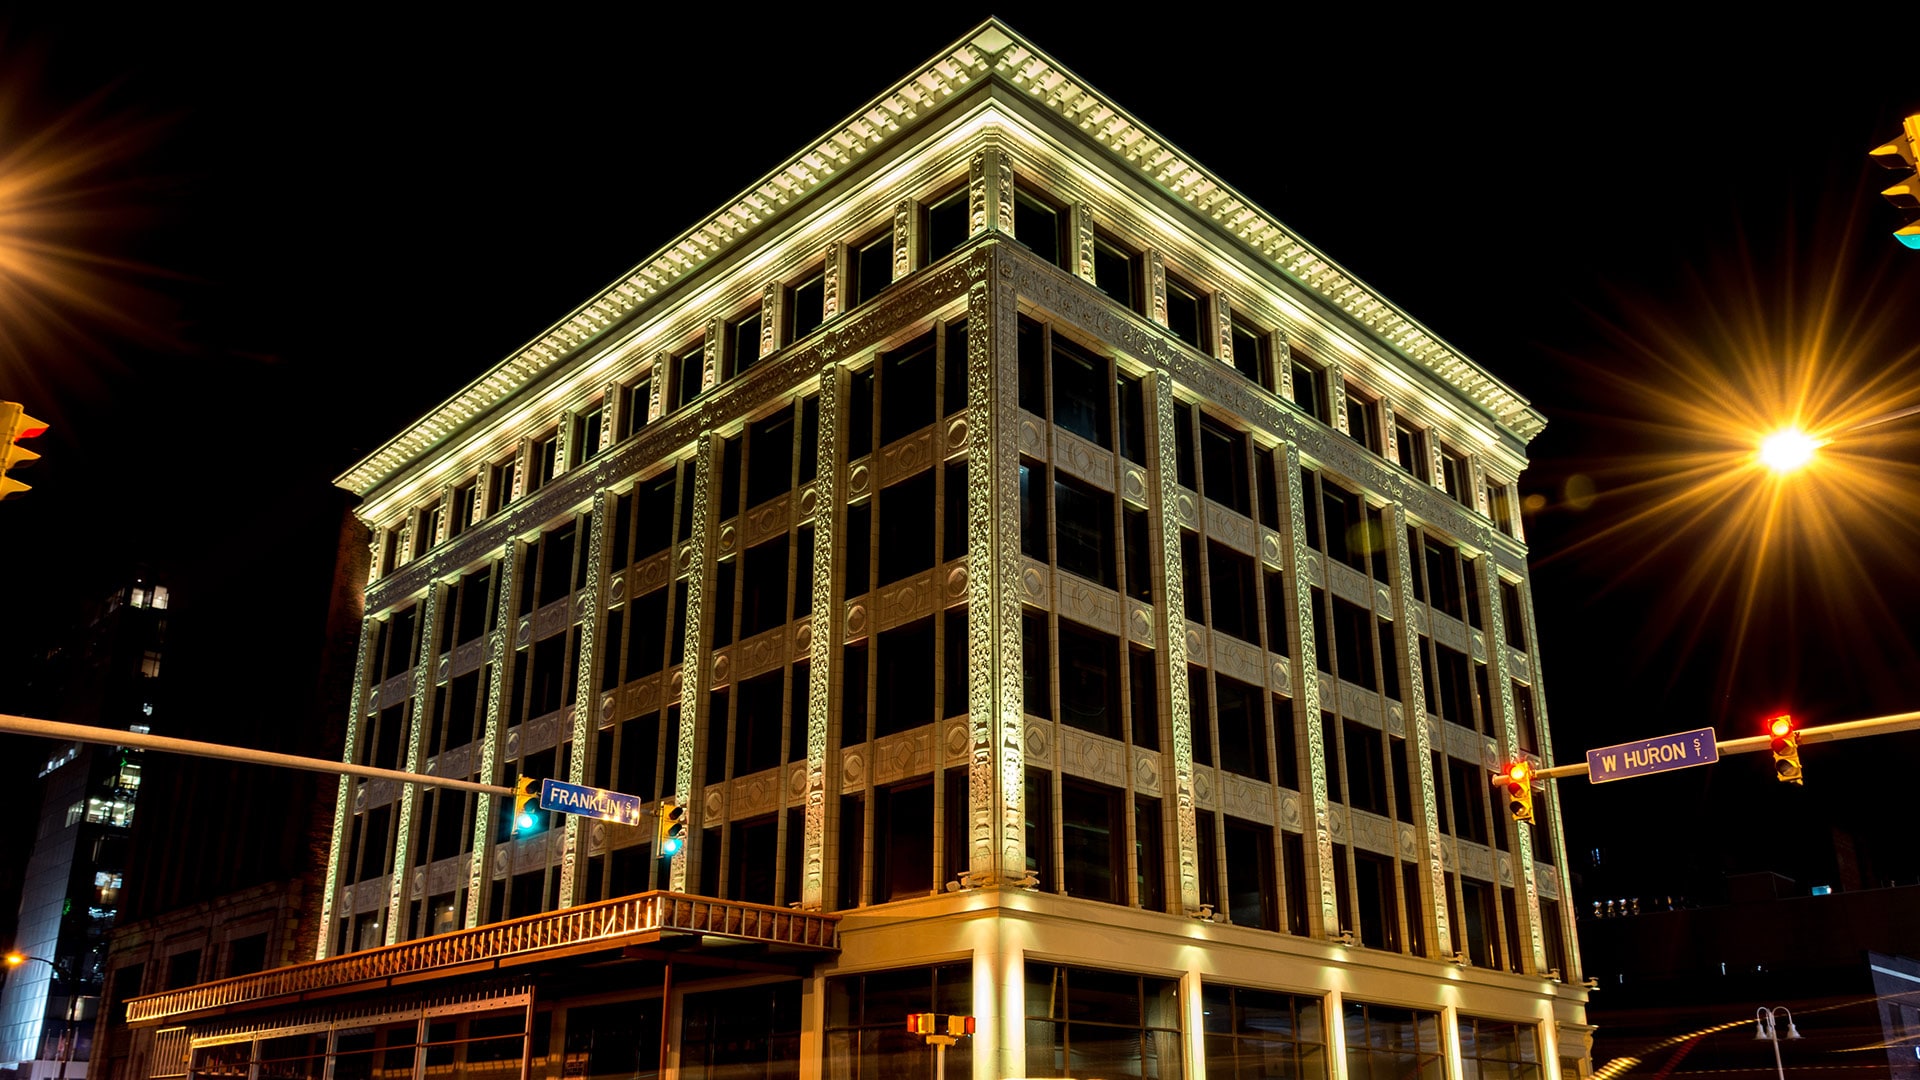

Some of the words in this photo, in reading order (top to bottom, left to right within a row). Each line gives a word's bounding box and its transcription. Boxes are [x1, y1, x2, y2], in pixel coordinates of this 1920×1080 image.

[1602, 755, 1617, 773] W
[1623, 742, 1687, 769] HURON
[1693, 738, 1701, 757] ST
[550, 787, 620, 815] FRANKLIN
[625, 802, 632, 818] ST
